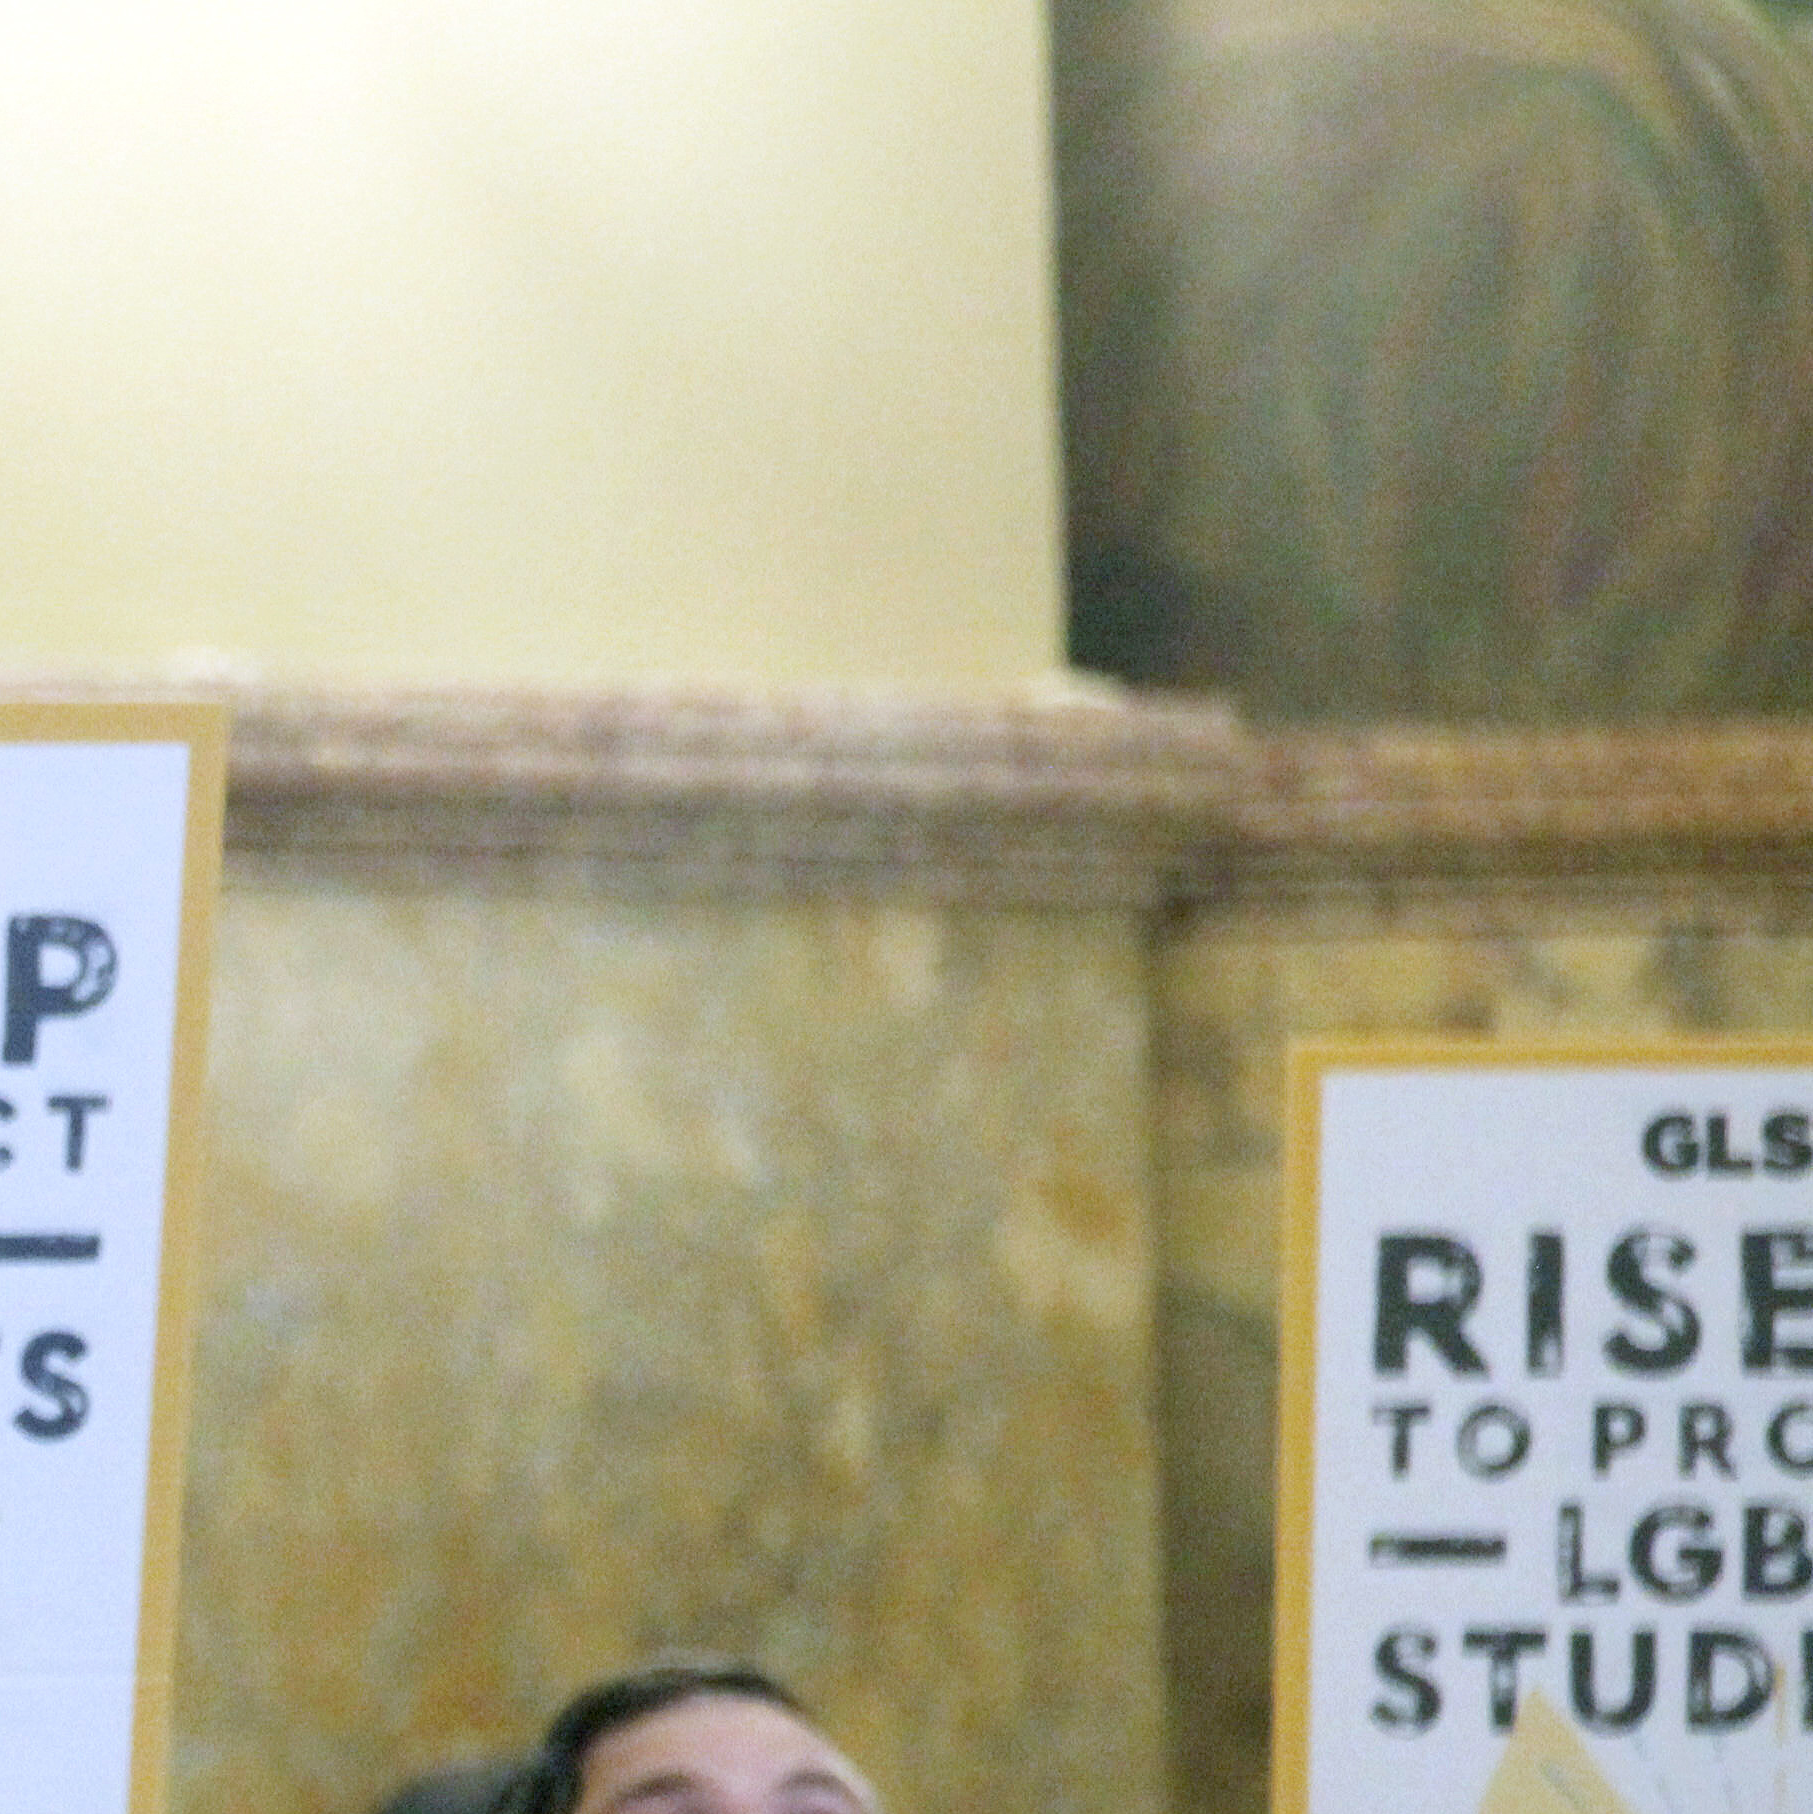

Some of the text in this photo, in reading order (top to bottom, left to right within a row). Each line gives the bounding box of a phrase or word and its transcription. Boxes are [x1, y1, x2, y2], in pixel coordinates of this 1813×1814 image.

[1372, 1224, 1813, 1379] RISE
[1372, 1402, 1532, 1481] TO
[1368, 1623, 1813, 1737] STUD
